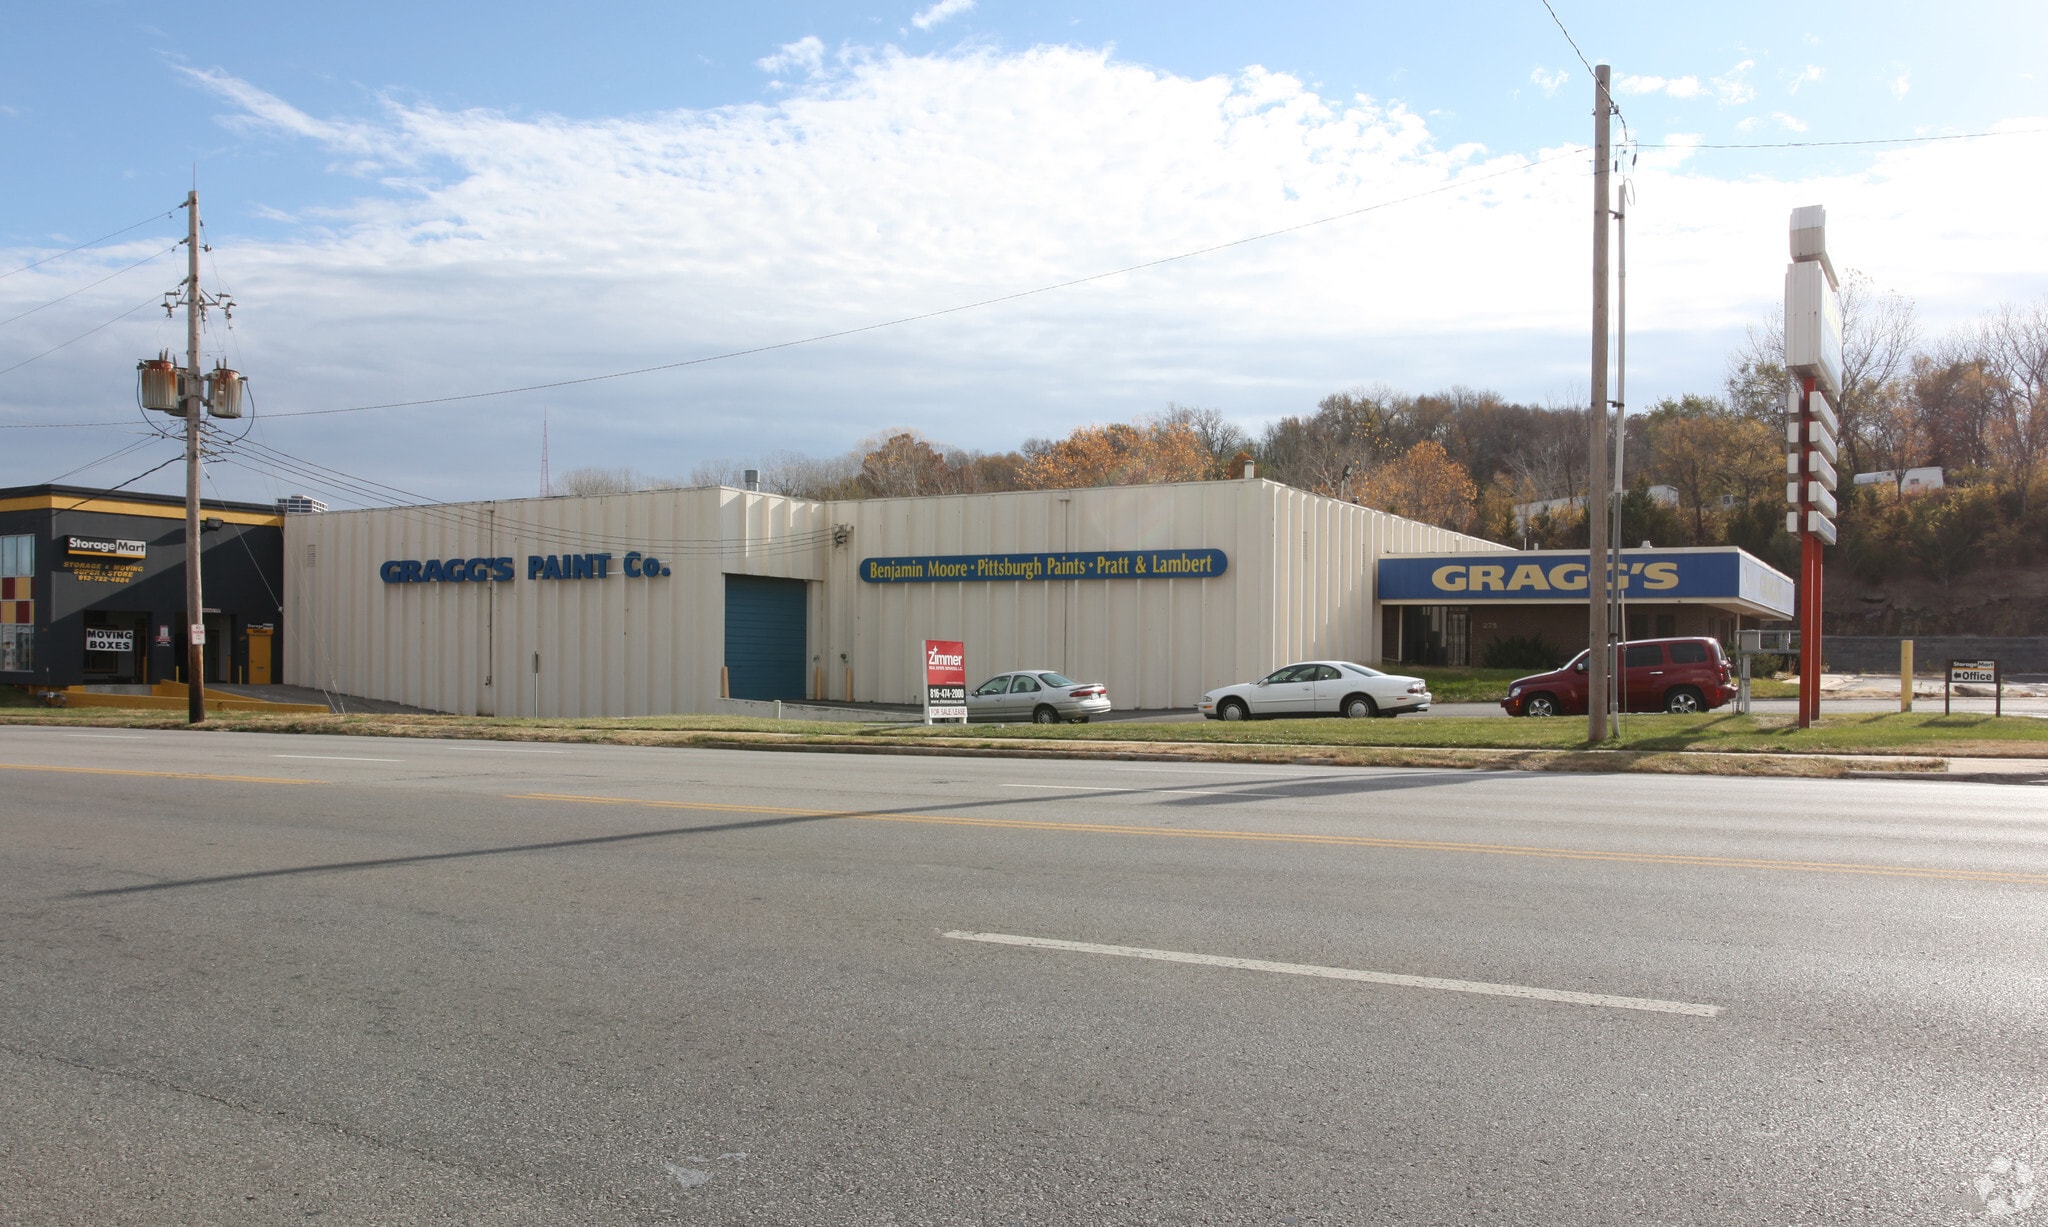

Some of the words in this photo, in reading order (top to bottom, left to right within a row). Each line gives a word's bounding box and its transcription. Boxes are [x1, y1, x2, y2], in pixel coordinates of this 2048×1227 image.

[63, 561, 102, 570] STORAGE
[113, 564, 144, 572] MOVING
[380, 557, 514, 583] GRAGG'S
[528, 553, 611, 580] PAINT
[624, 551, 671, 578] Co.
[870, 560, 923, 581] Benjamin
[928, 560, 967, 577] Moore
[978, 557, 1042, 580] Pittsburgh
[1047, 556, 1086, 575] Paints
[1097, 556, 1129, 574] Pratt
[1135, 555, 1146, 573] &
[1153, 553, 1212, 573] Lambert
[88, 630, 132, 639] MOVING
[90, 641, 130, 649] BOXES
[928, 649, 962, 666] Zimmer
[1962, 671, 1992, 680] Office
[930, 688, 964, 698] 816-474-2000
